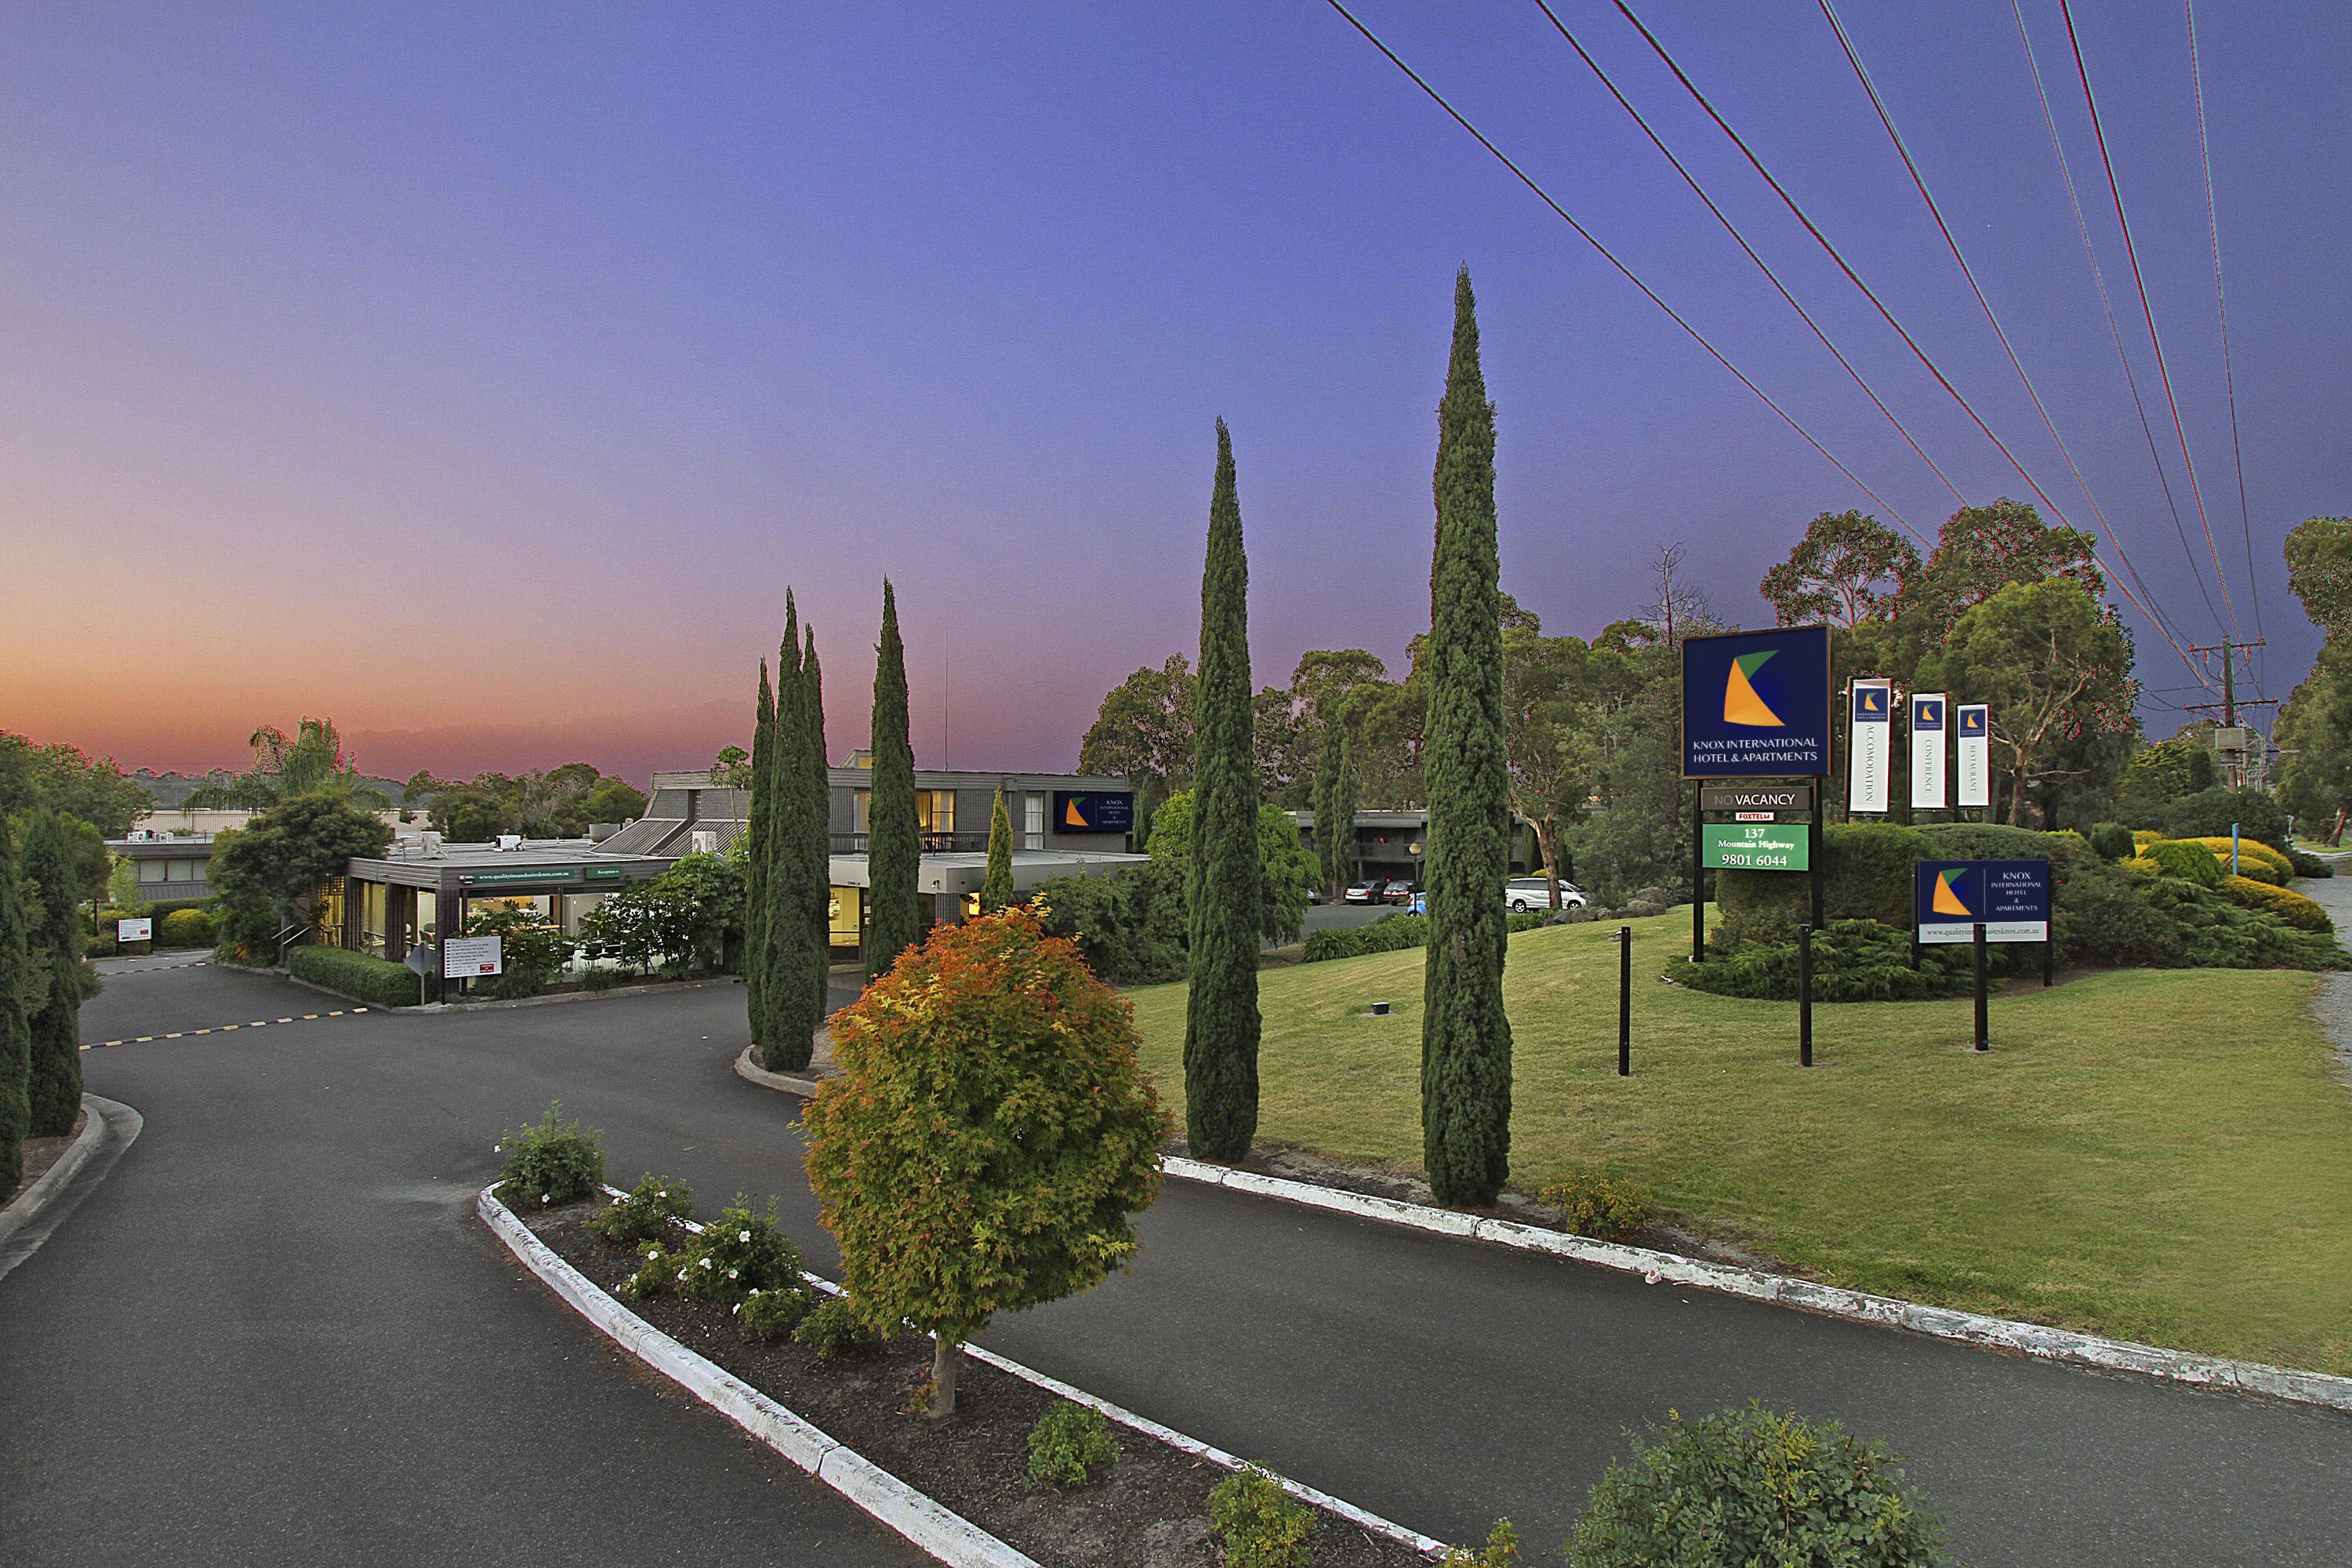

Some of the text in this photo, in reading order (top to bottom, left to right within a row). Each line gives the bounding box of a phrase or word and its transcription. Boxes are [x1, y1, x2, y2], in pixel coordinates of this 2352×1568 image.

[1693, 738, 1818, 750] KNOX INTERNATIONAL
[1693, 752, 1818, 763] HOTEL & APARTMENTS
[1865, 724, 1875, 802] ACCOMODATION
[1715, 794, 1795, 805] NO VACANCY
[1744, 828, 1766, 838] 137
[1718, 840, 1795, 851] Mountain Highway
[1722, 854, 1788, 866] 9801 6044
